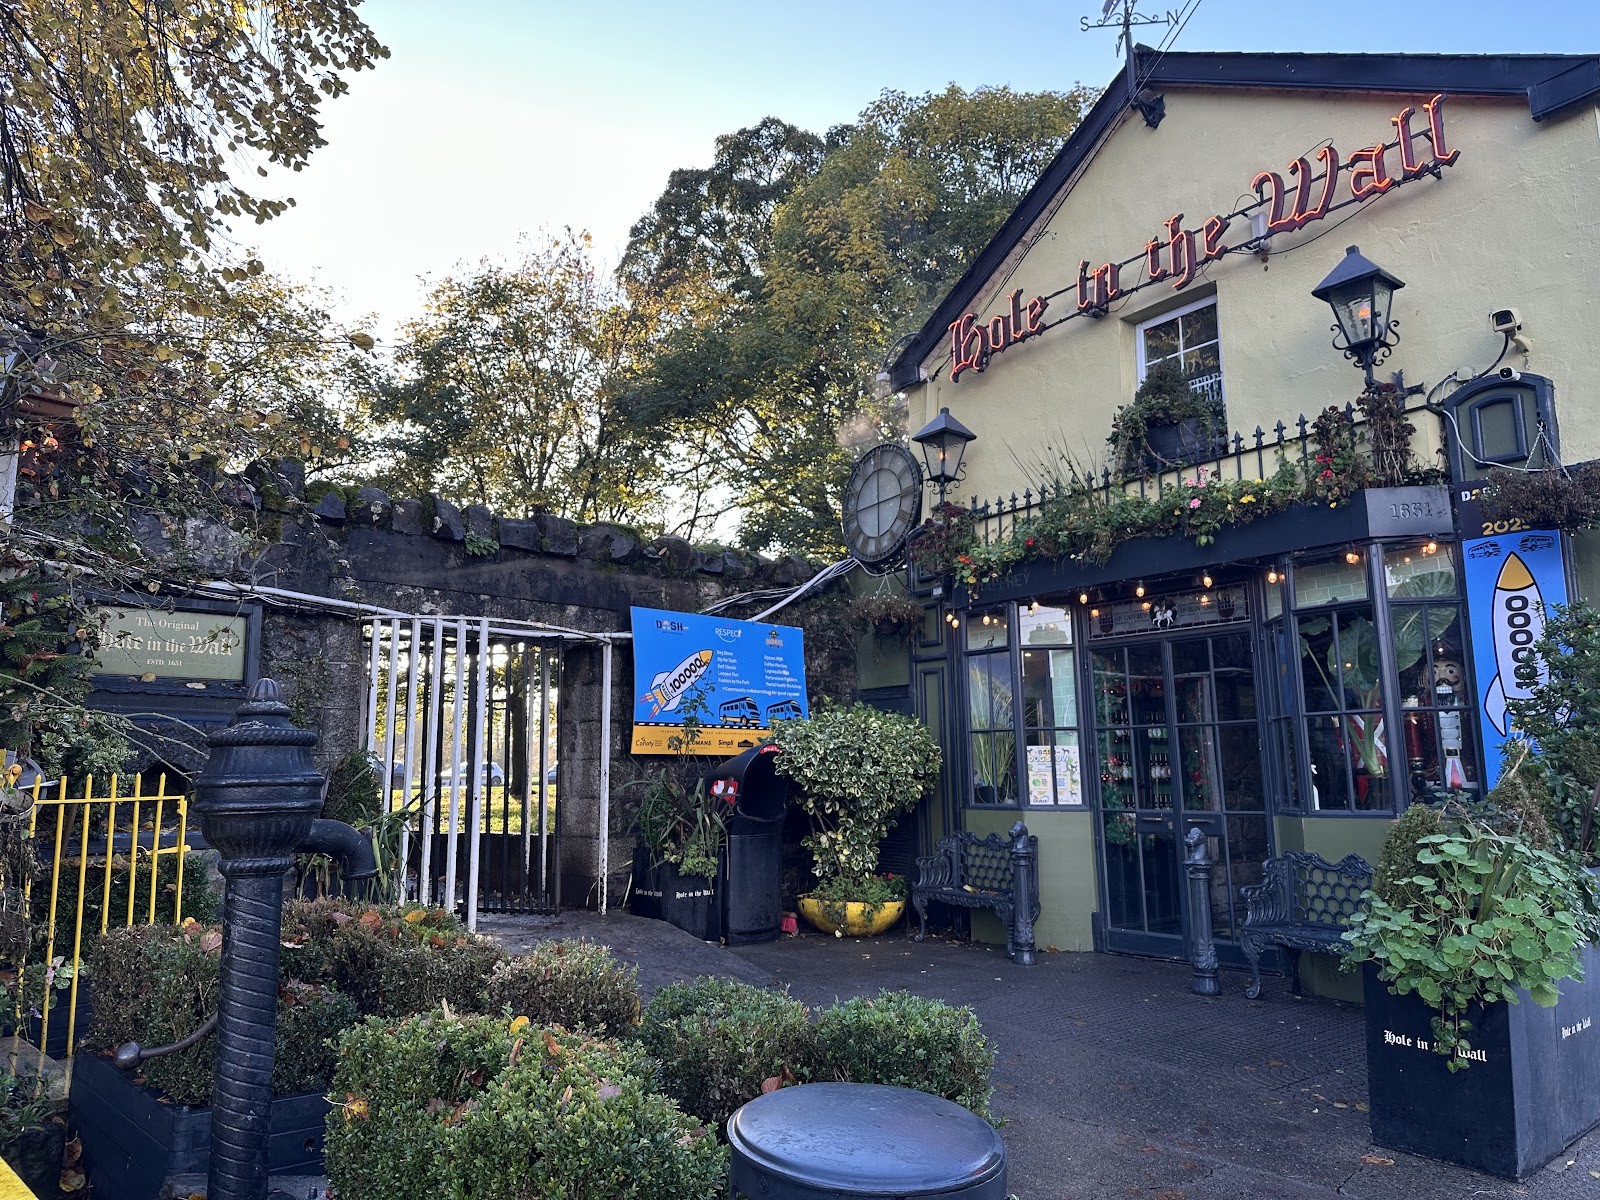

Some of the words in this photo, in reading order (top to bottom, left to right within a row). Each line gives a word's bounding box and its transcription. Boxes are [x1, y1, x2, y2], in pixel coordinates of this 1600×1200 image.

[949, 288, 1049, 384] Hole
[1076, 259, 1123, 313] in
[1144, 213, 1231, 291] the
[1250, 93, 1461, 234] Wall
[1481, 516, 1532, 536] 202
[136, 616, 156, 627] The
[158, 618, 200, 631] Original
[715, 627, 742, 638] RESPECT
[147, 636, 161, 651] in
[165, 636, 186, 656] the
[188, 635, 233, 656] Wall
[167, 659, 183, 667] 1651
[1383, 1029, 1413, 1047] Hole
[1416, 1036, 1429, 1051] in
